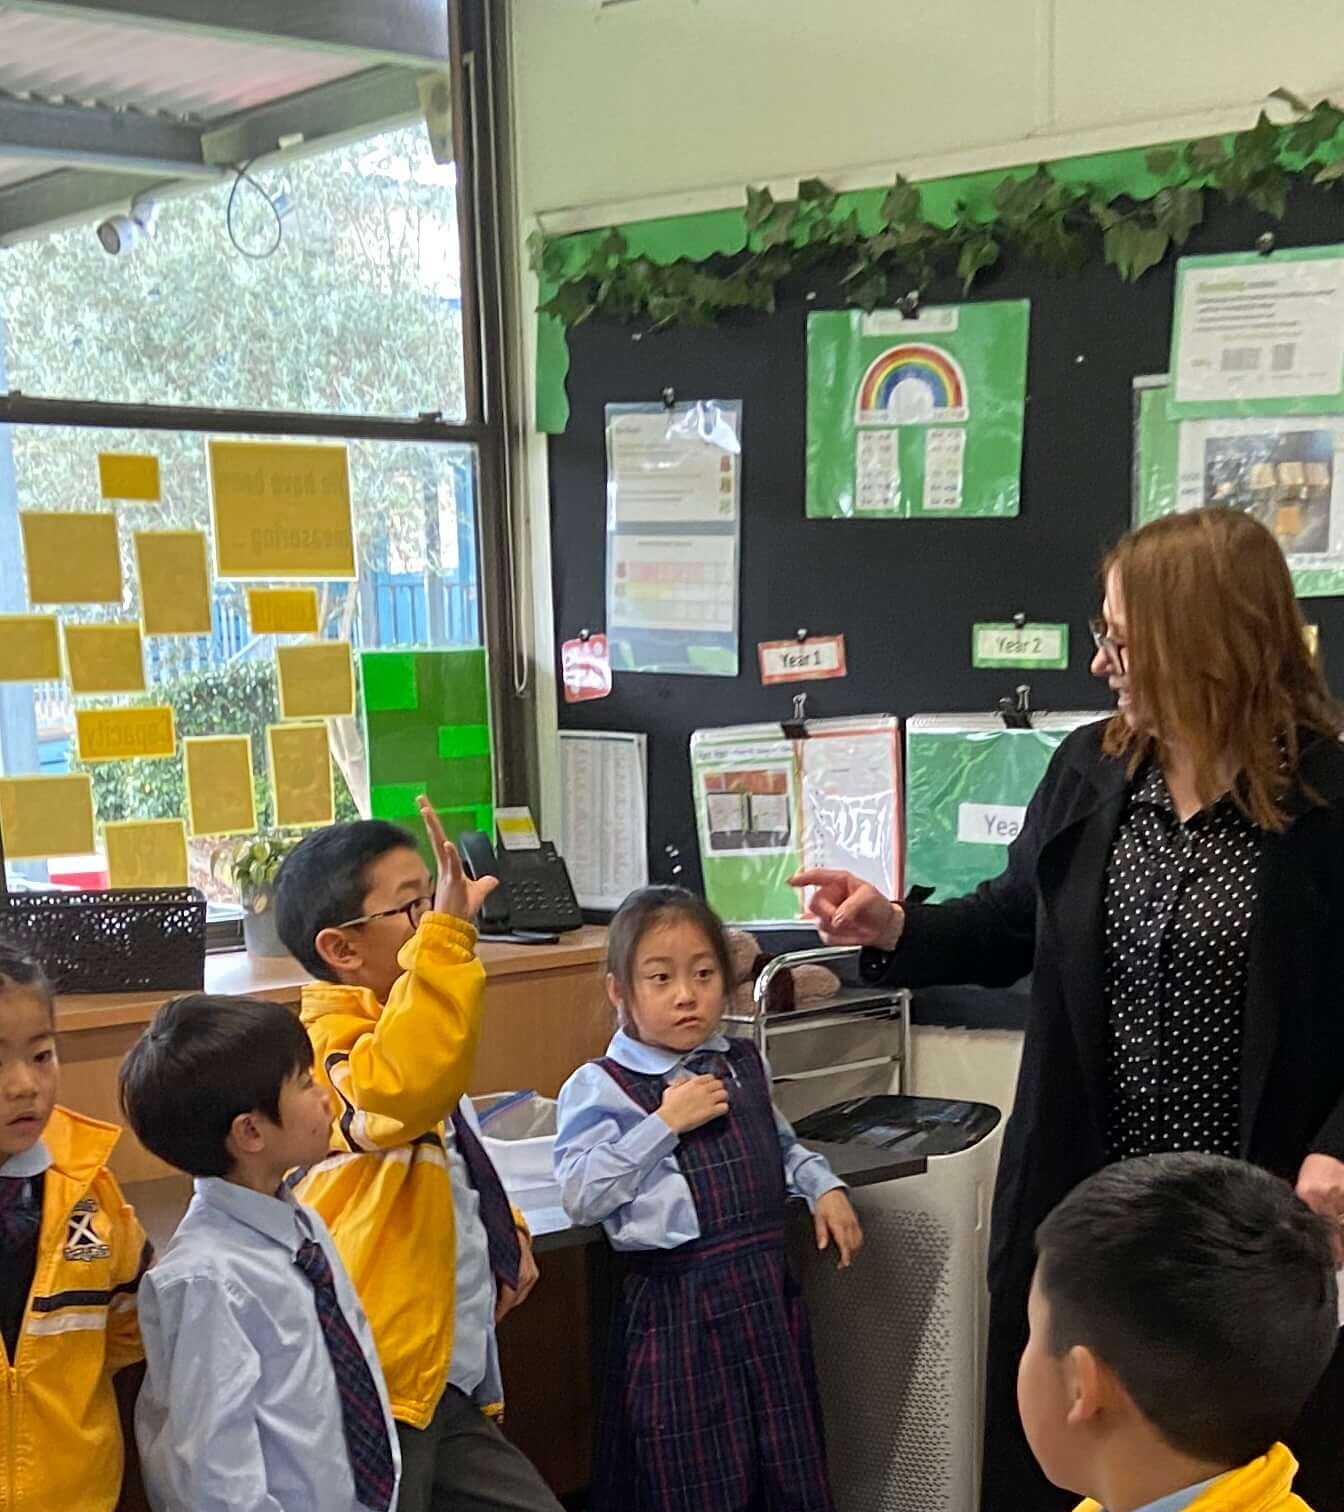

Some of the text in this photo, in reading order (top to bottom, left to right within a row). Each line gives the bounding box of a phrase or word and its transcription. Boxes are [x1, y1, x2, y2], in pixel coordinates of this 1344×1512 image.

[996, 636, 1042, 653] Year 2
[780, 651, 822, 667] Year 1
[984, 812, 1019, 836] Yea
